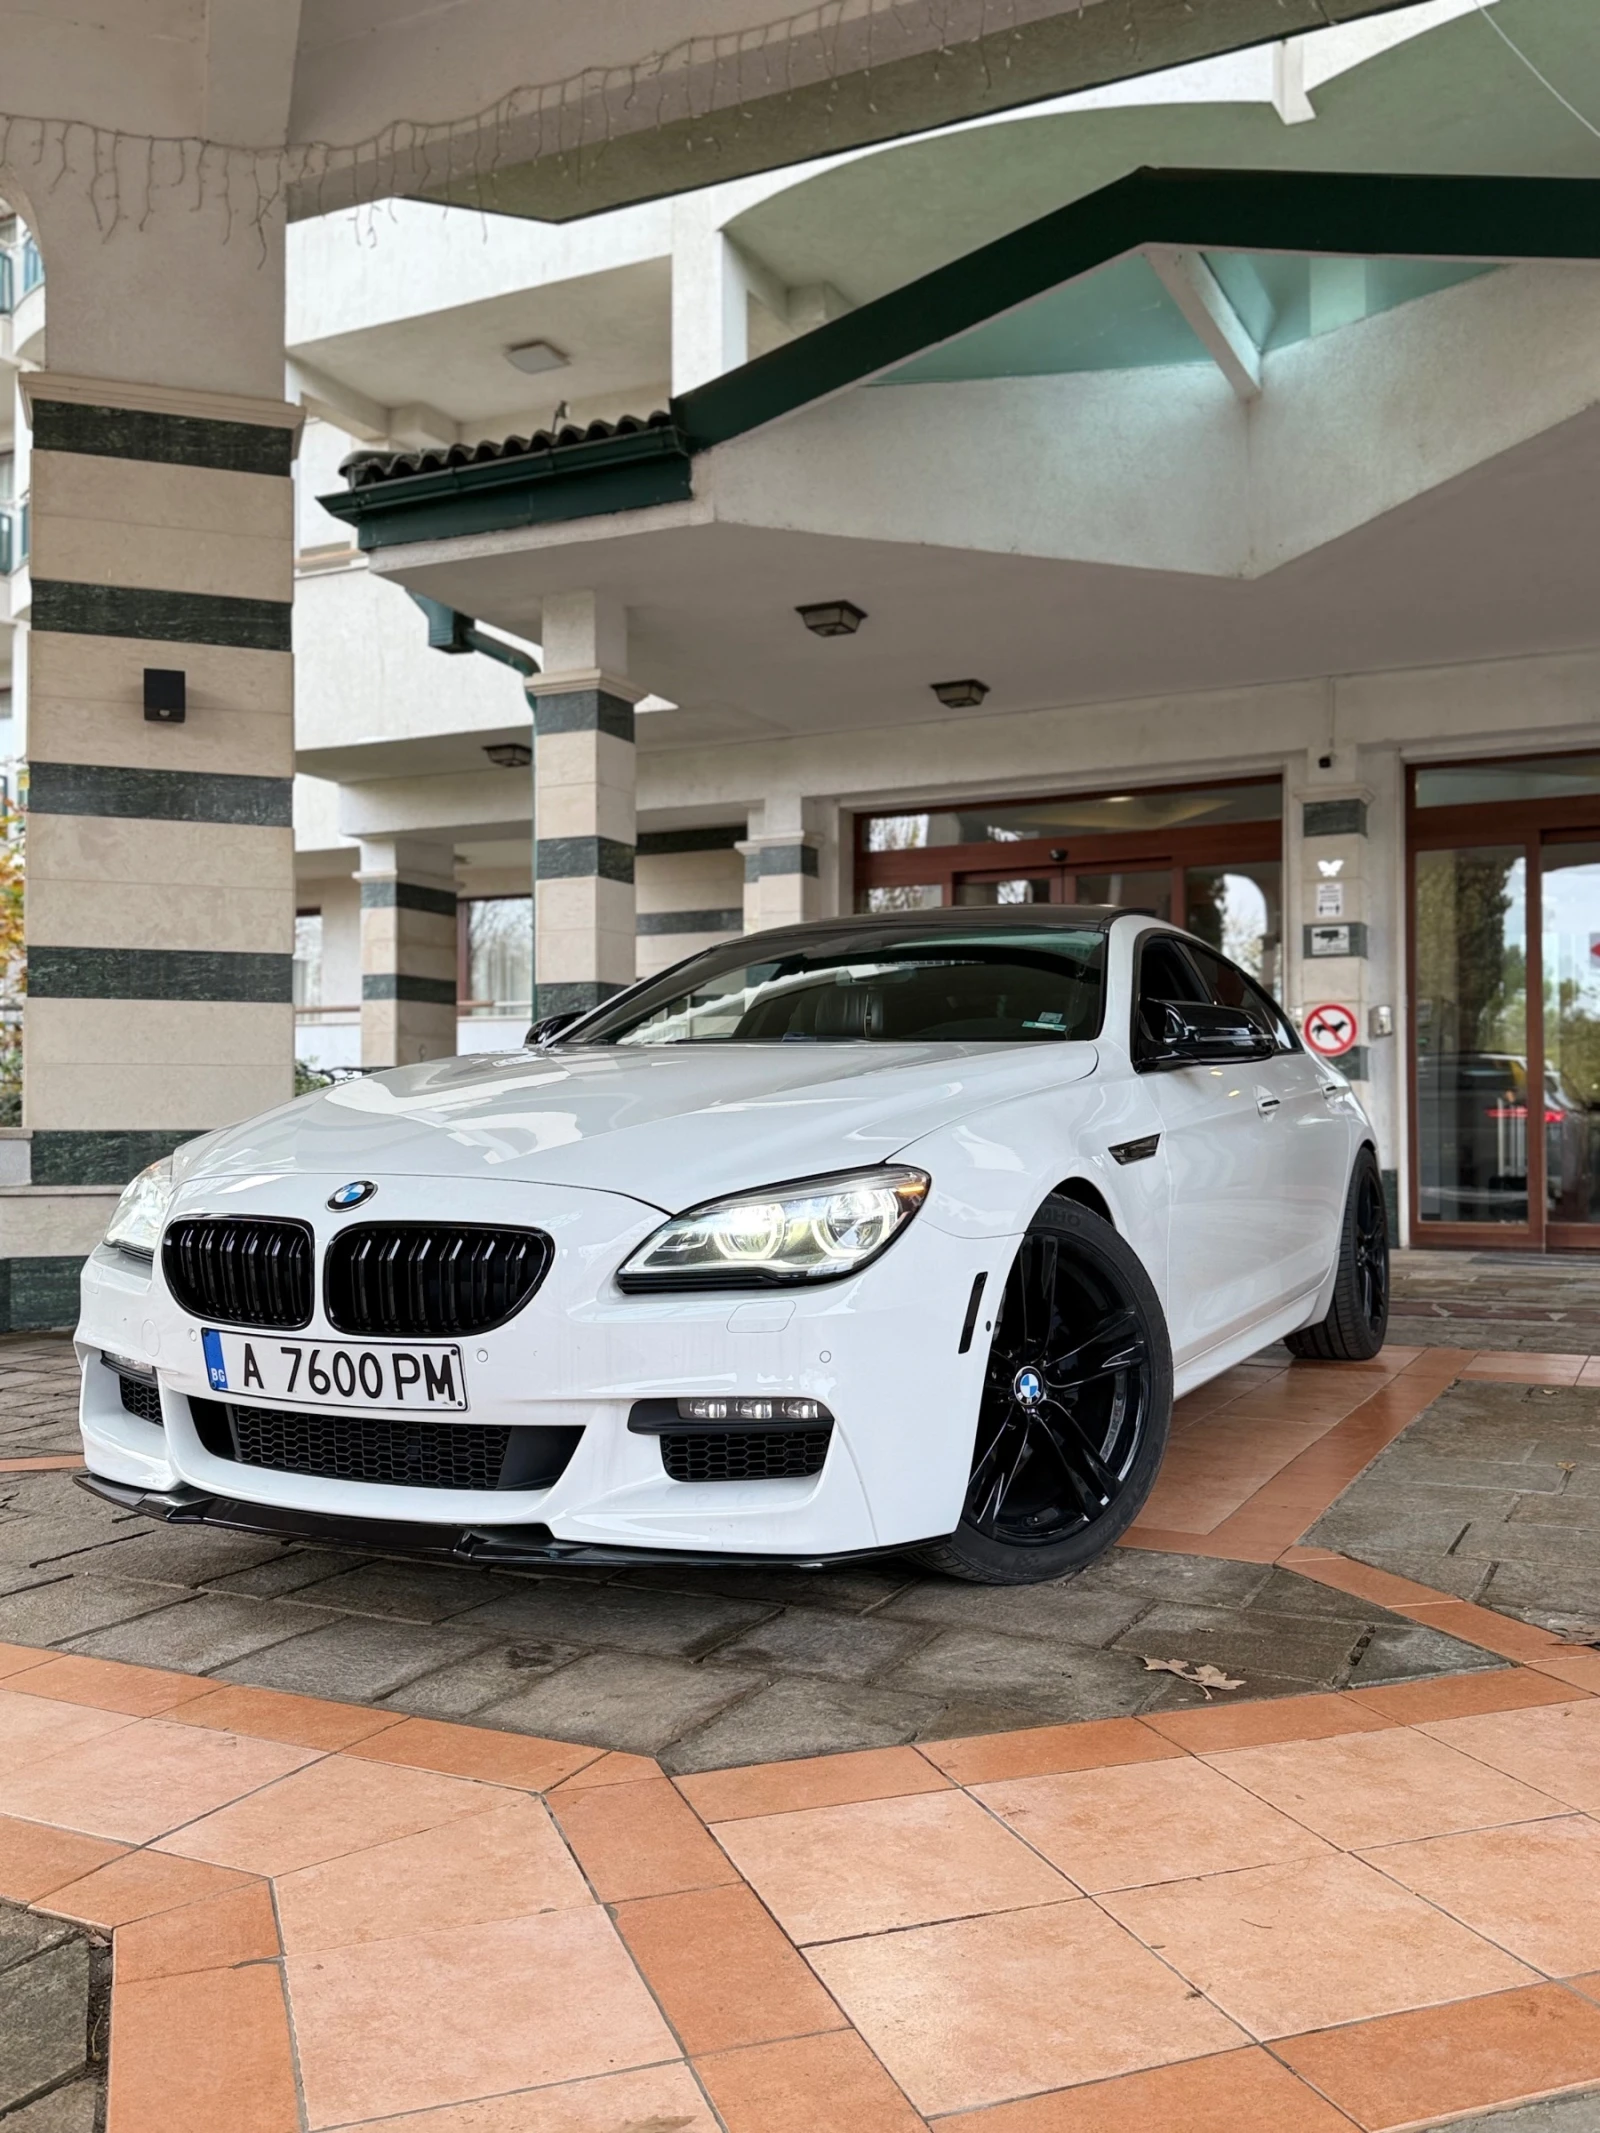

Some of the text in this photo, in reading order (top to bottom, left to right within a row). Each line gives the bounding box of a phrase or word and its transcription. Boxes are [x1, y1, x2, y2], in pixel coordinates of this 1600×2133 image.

[210, 1367, 226, 1383] BG
[243, 1343, 456, 1401] A 7600 PM
